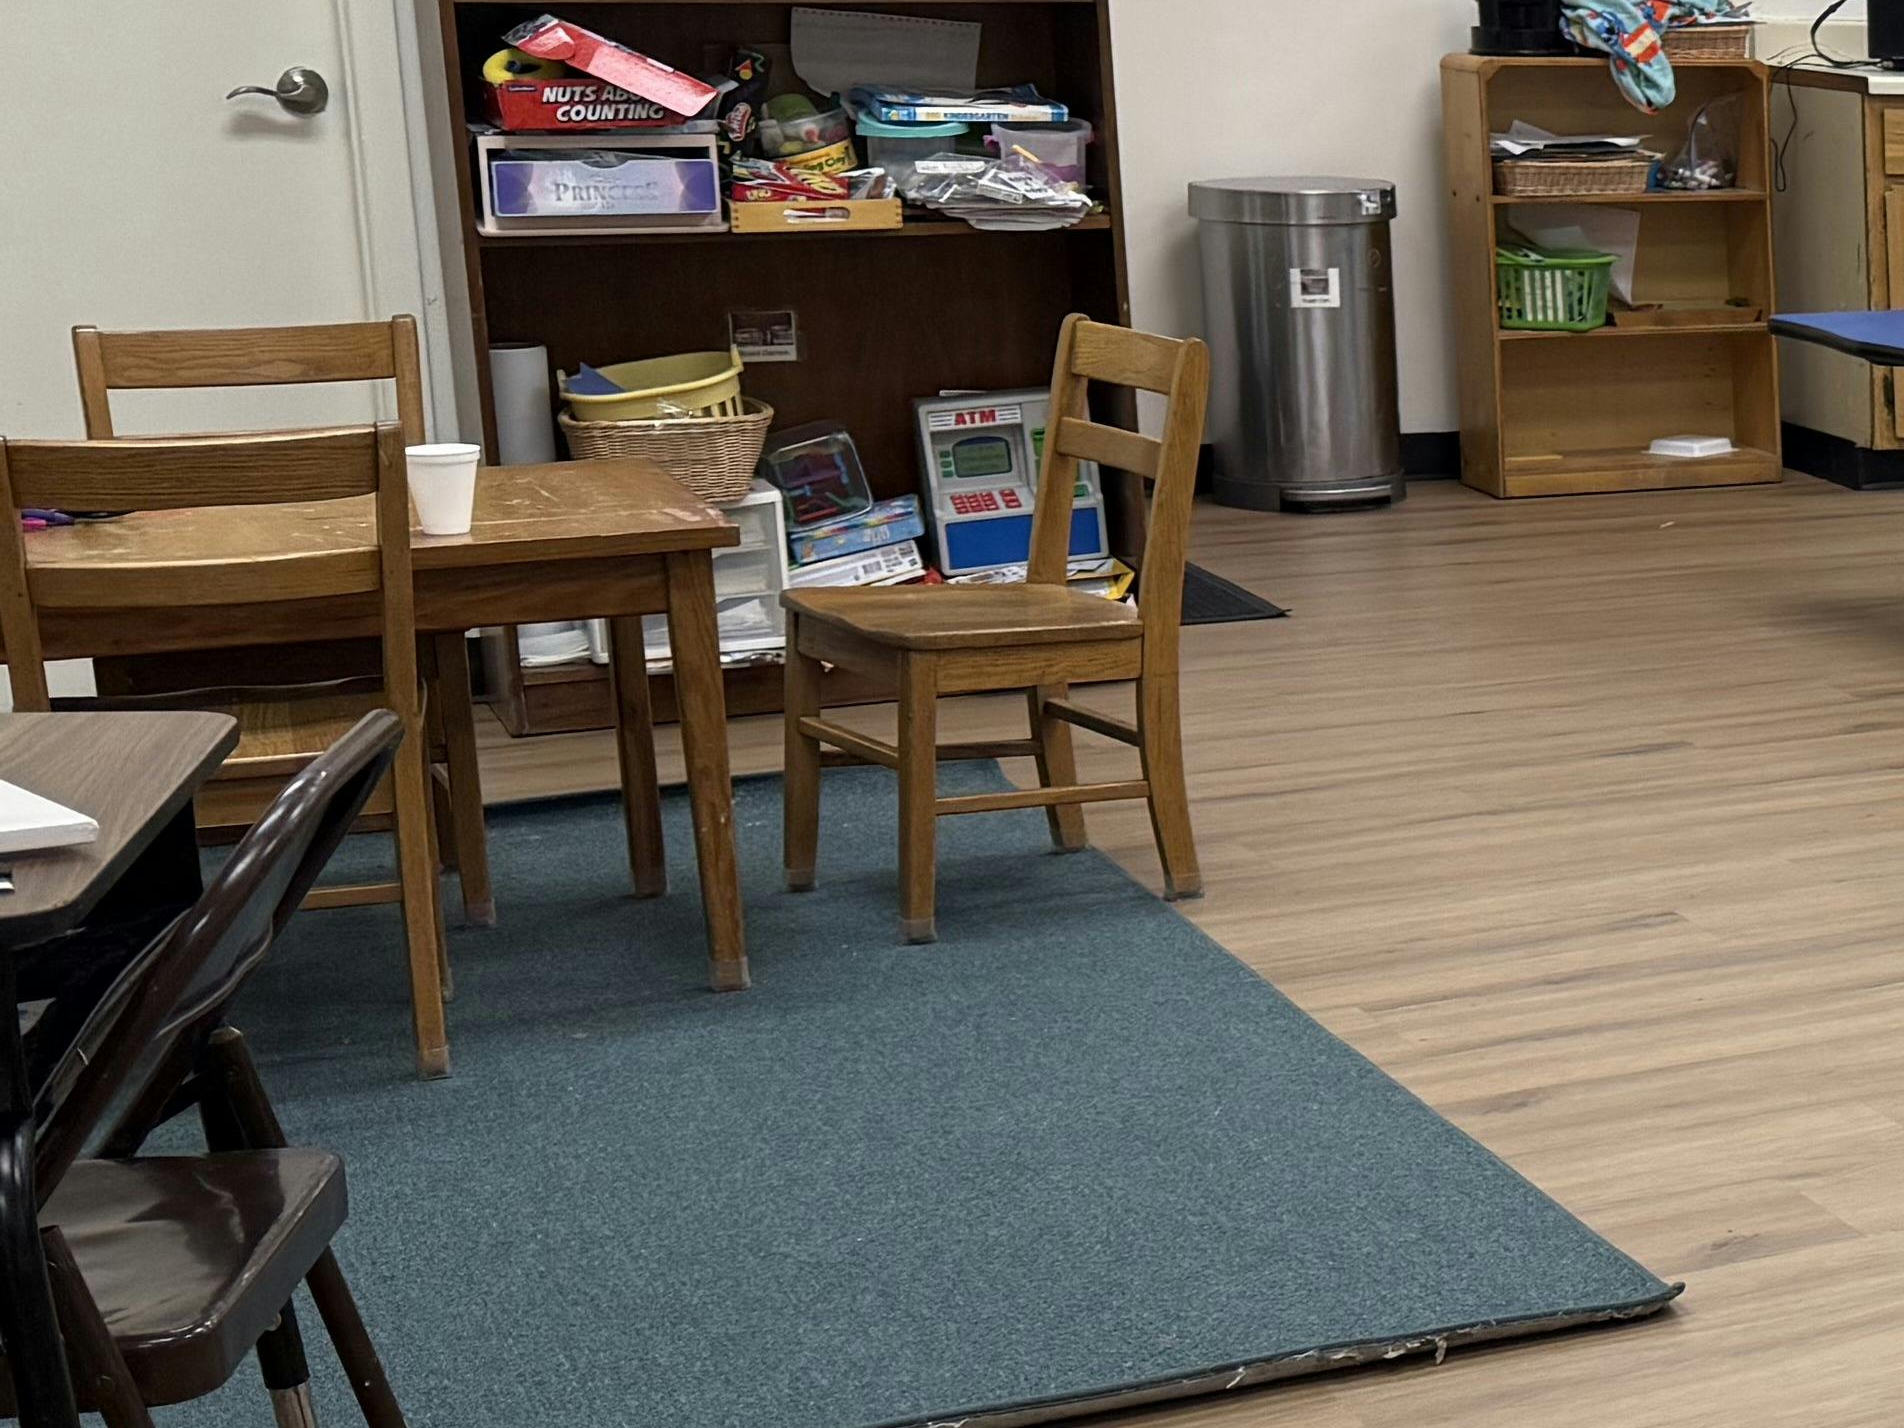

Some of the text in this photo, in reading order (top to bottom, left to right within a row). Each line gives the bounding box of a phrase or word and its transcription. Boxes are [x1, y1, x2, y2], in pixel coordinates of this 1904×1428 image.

[542, 86, 598, 103] NUTS
[556, 104, 664, 121] COUNTING
[943, 112, 1009, 121] KINDERGARTEN
[954, 409, 997, 425] ATM
